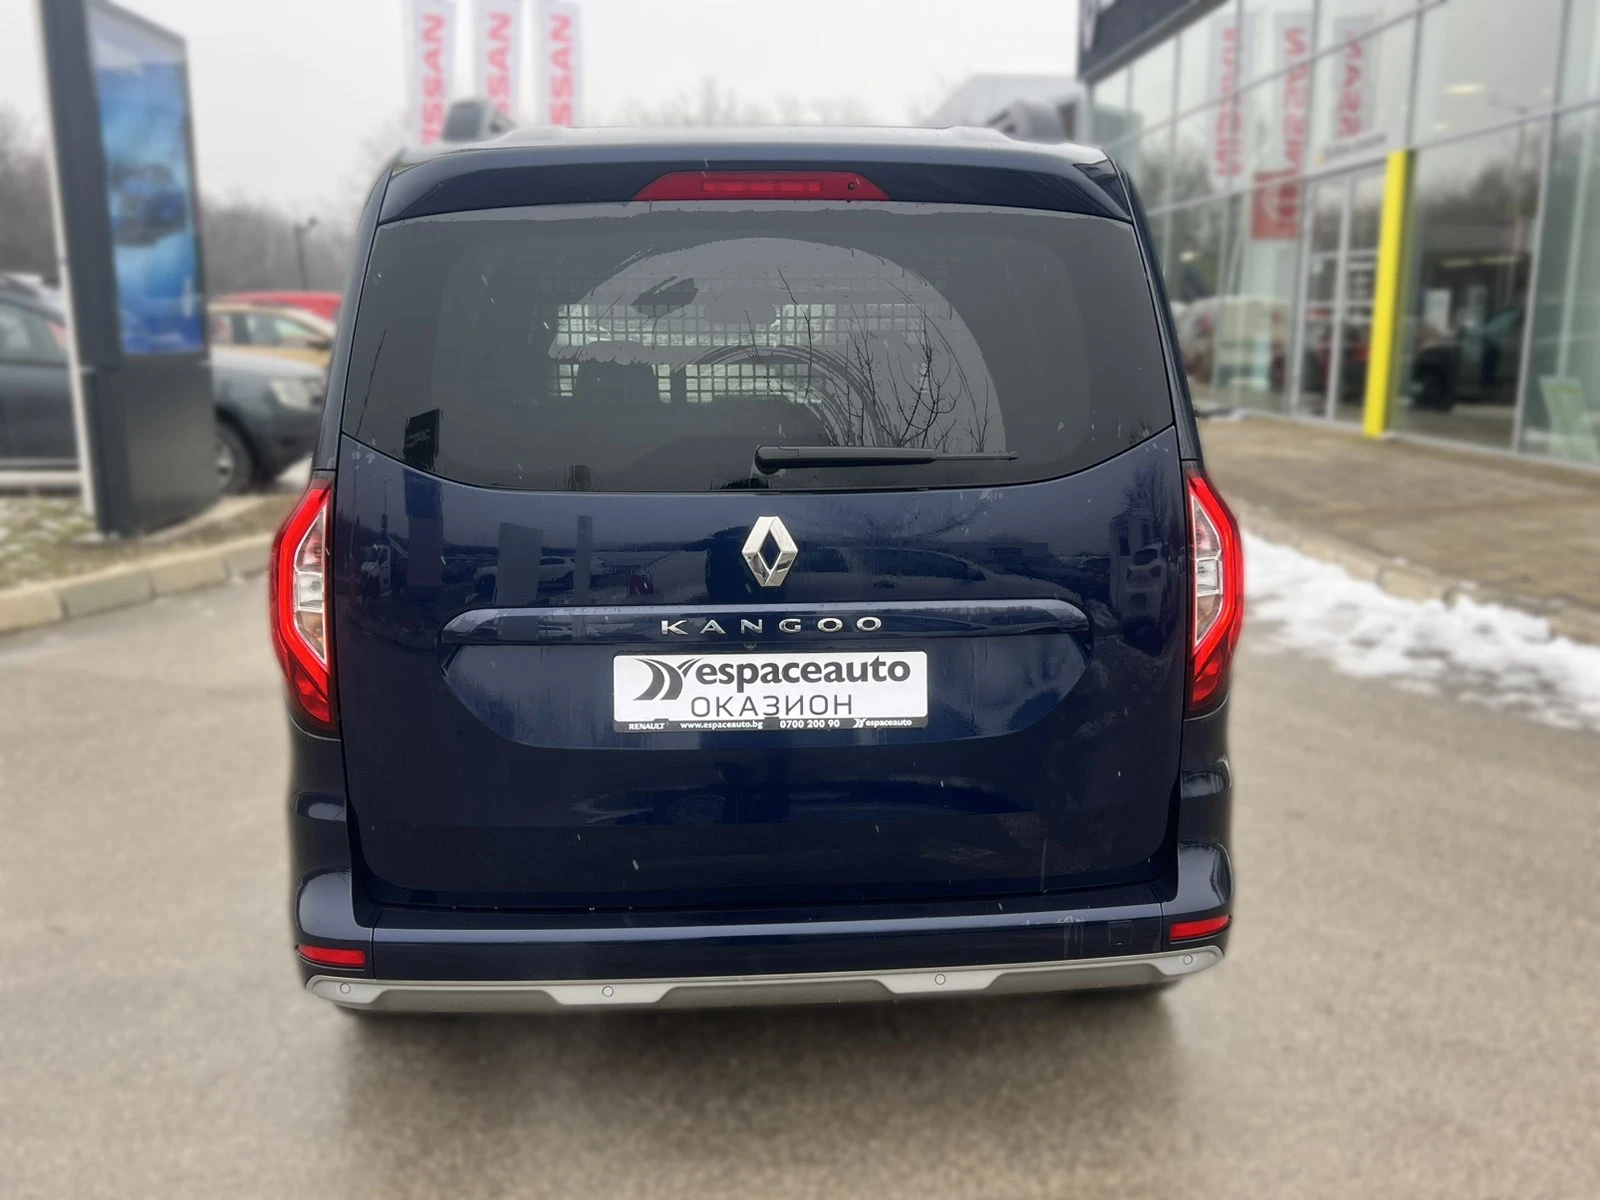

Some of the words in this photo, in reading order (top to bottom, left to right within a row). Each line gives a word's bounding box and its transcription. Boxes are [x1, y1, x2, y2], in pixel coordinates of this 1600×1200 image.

[661, 617, 882, 635] KANGOO
[695, 655, 911, 693] espaceauto
[690, 694, 852, 717] ОКАЗИОН
[628, 722, 666, 730] RENAULT
[680, 720, 764, 730] www.espaceauto.bg
[779, 719, 804, 729] 0700
[806, 719, 826, 728] 200
[827, 719, 840, 728] 90
[865, 718, 913, 728] espaceauto
